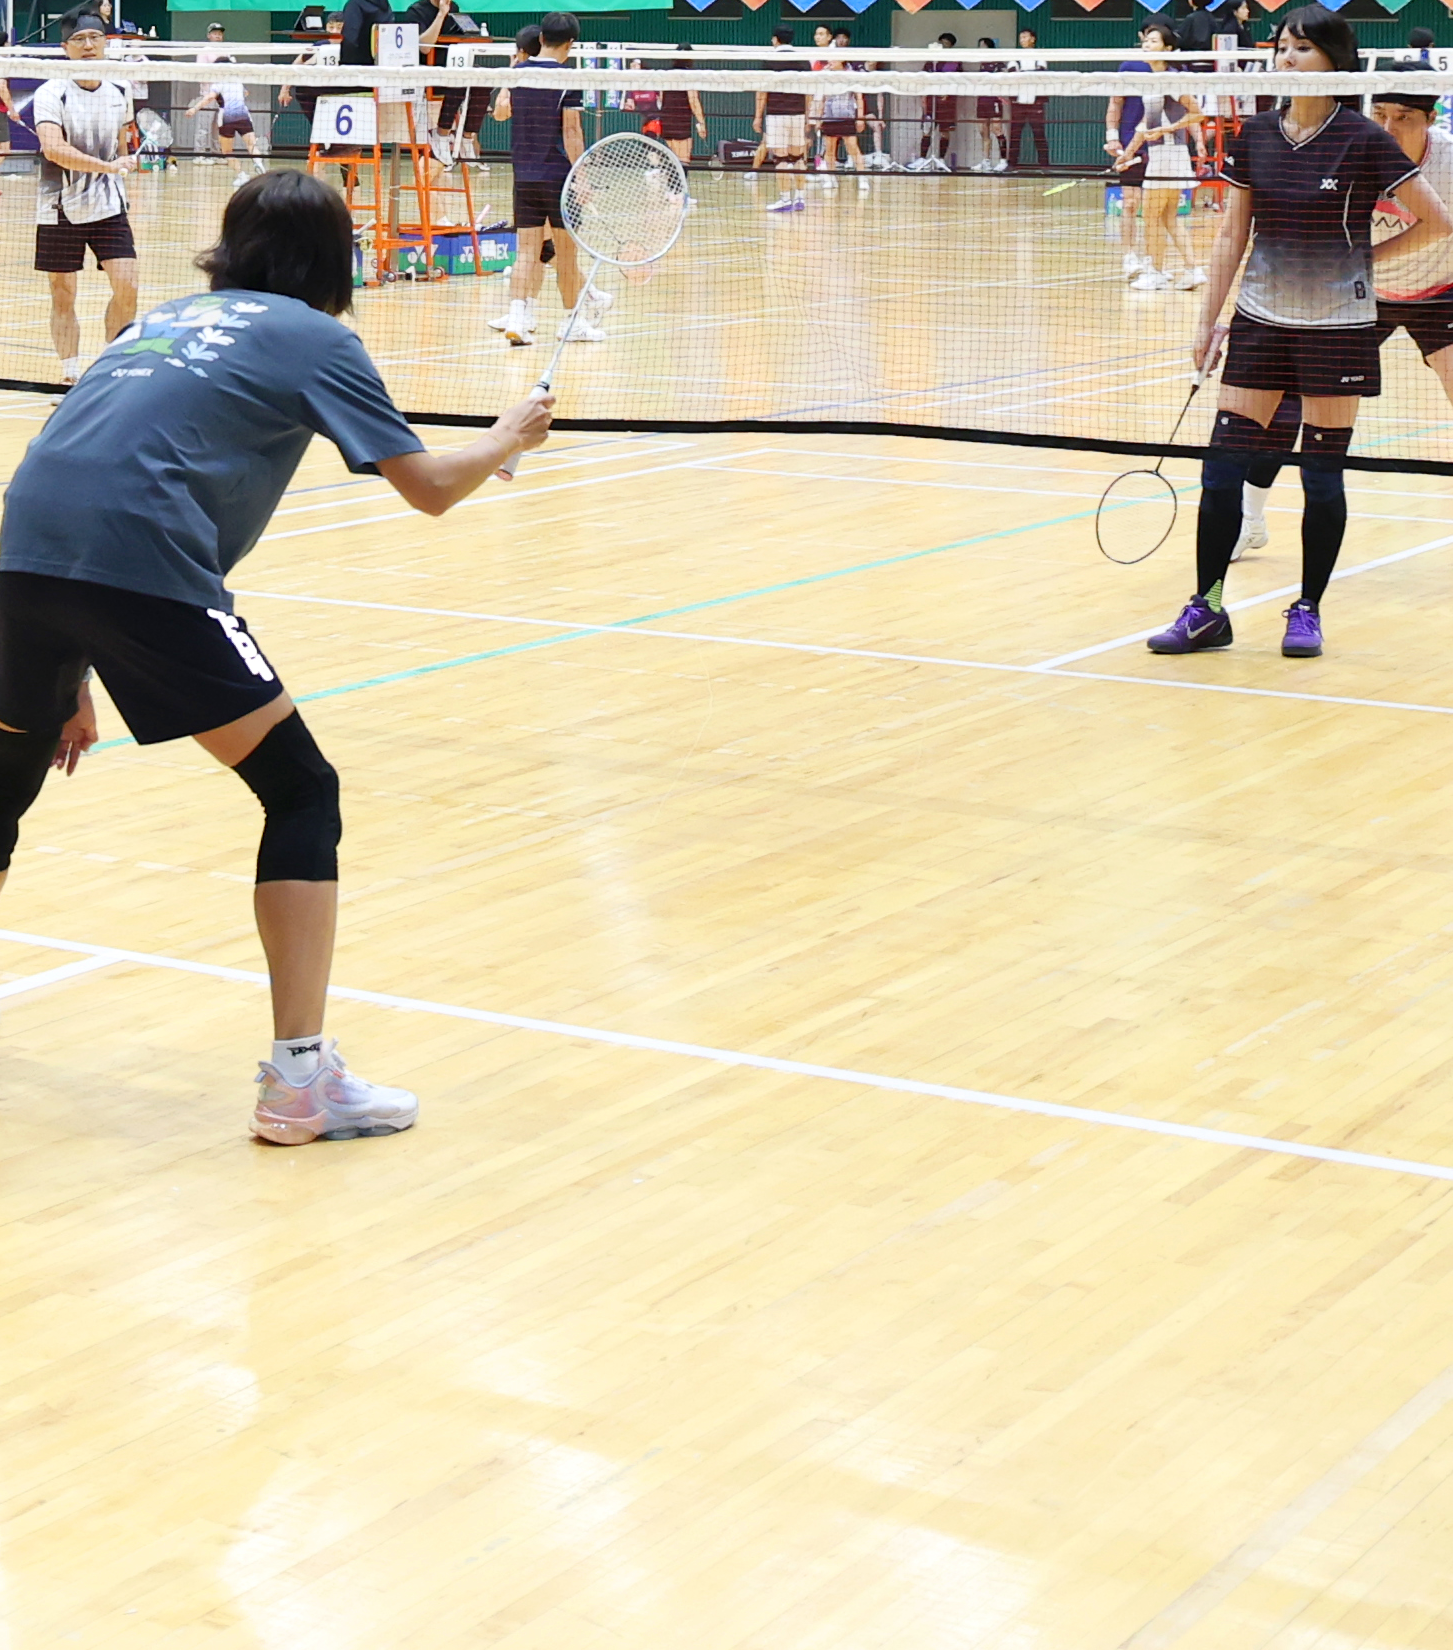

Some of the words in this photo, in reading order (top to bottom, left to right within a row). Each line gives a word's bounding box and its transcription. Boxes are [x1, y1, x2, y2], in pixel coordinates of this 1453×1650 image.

[395, 26, 404, 49] 6
[450, 54, 466, 68] 13
[1438, 56, 1449, 72] 5
[334, 104, 353, 136] 6
